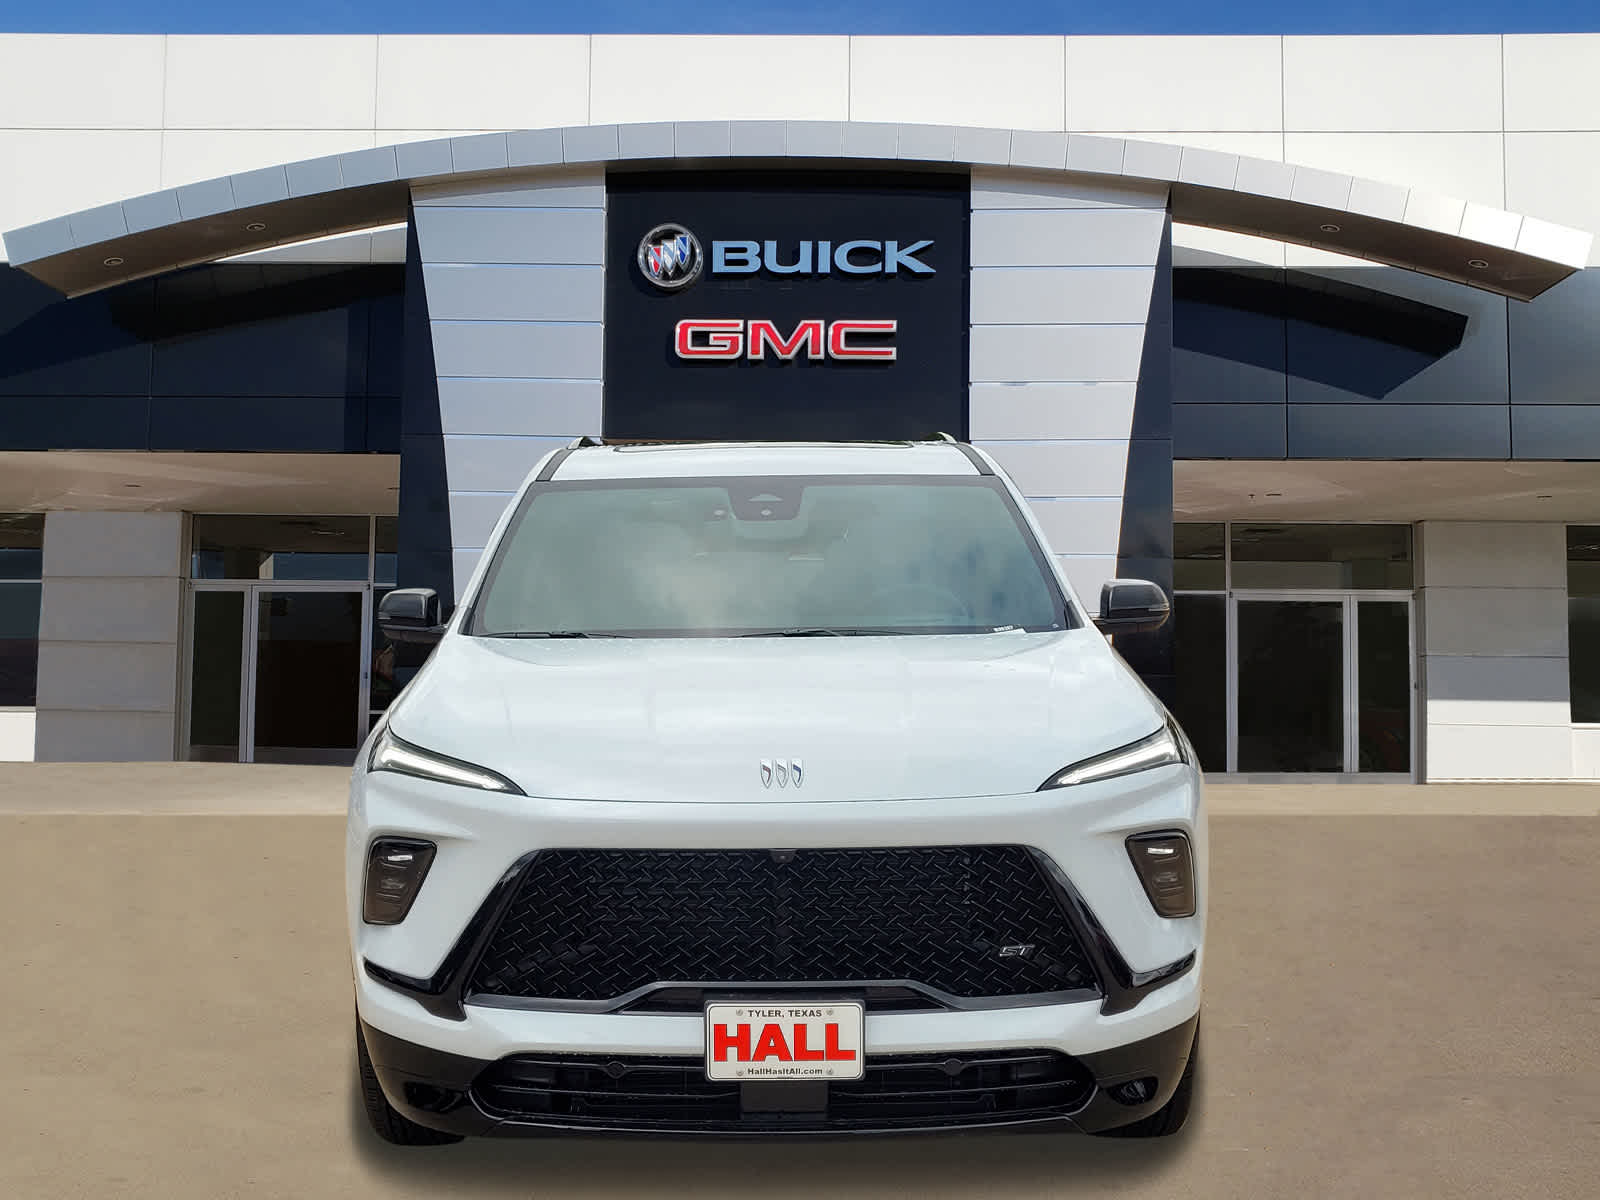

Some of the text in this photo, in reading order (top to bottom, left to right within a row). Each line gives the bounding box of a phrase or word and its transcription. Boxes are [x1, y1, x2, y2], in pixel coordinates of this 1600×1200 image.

[712, 240, 936, 273] BUICK
[675, 319, 897, 360] GMC
[748, 1009, 822, 1018] TYLER, TEXAS
[713, 1023, 857, 1062] HALL
[747, 1068, 823, 1076] HallHasItAll.com
